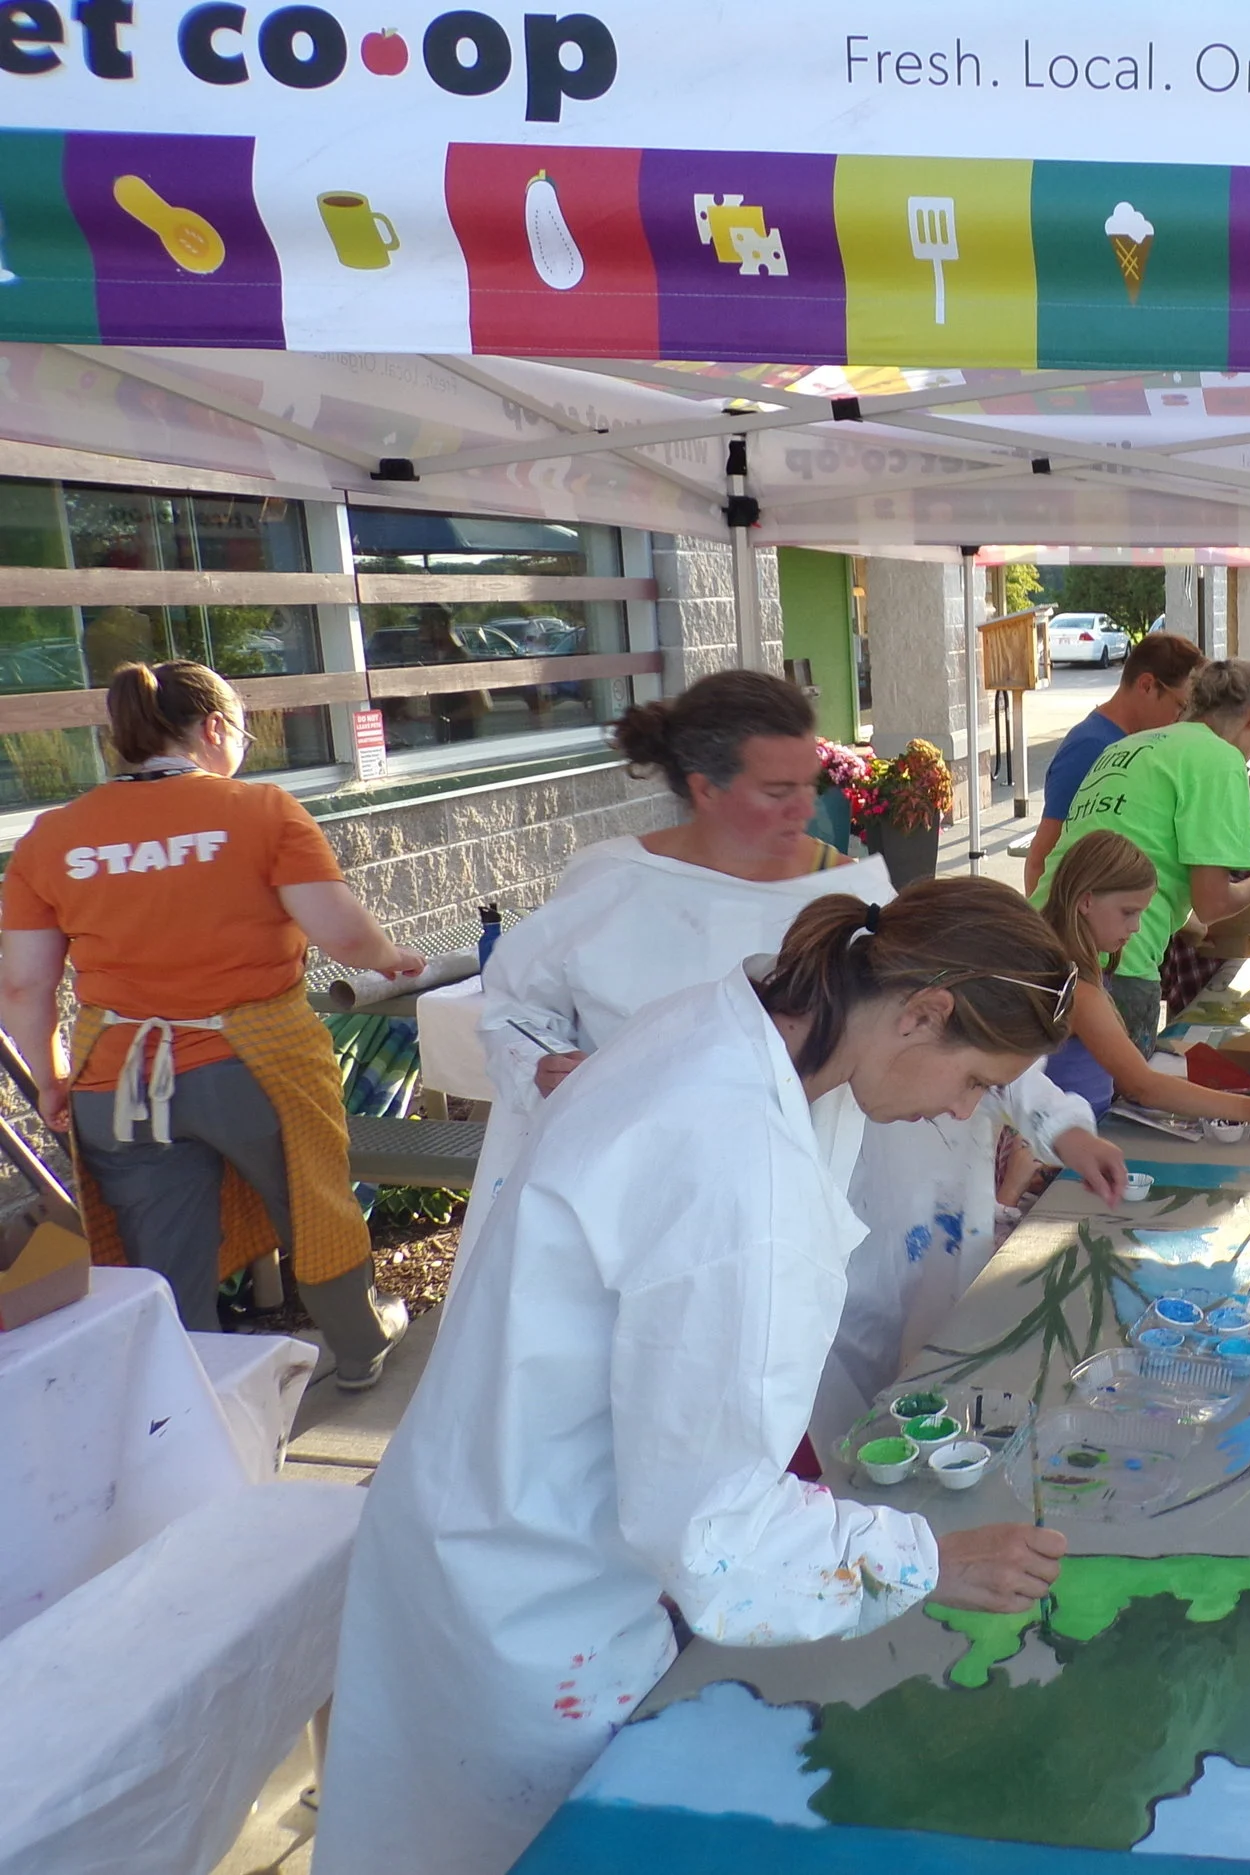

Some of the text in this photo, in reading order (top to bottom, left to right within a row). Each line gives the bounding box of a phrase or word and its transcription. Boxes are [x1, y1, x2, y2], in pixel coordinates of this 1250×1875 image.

[845, 35, 1000, 88] Fresh.
[1023, 39, 1172, 92] Local.
[64, 830, 228, 880] STAFF
